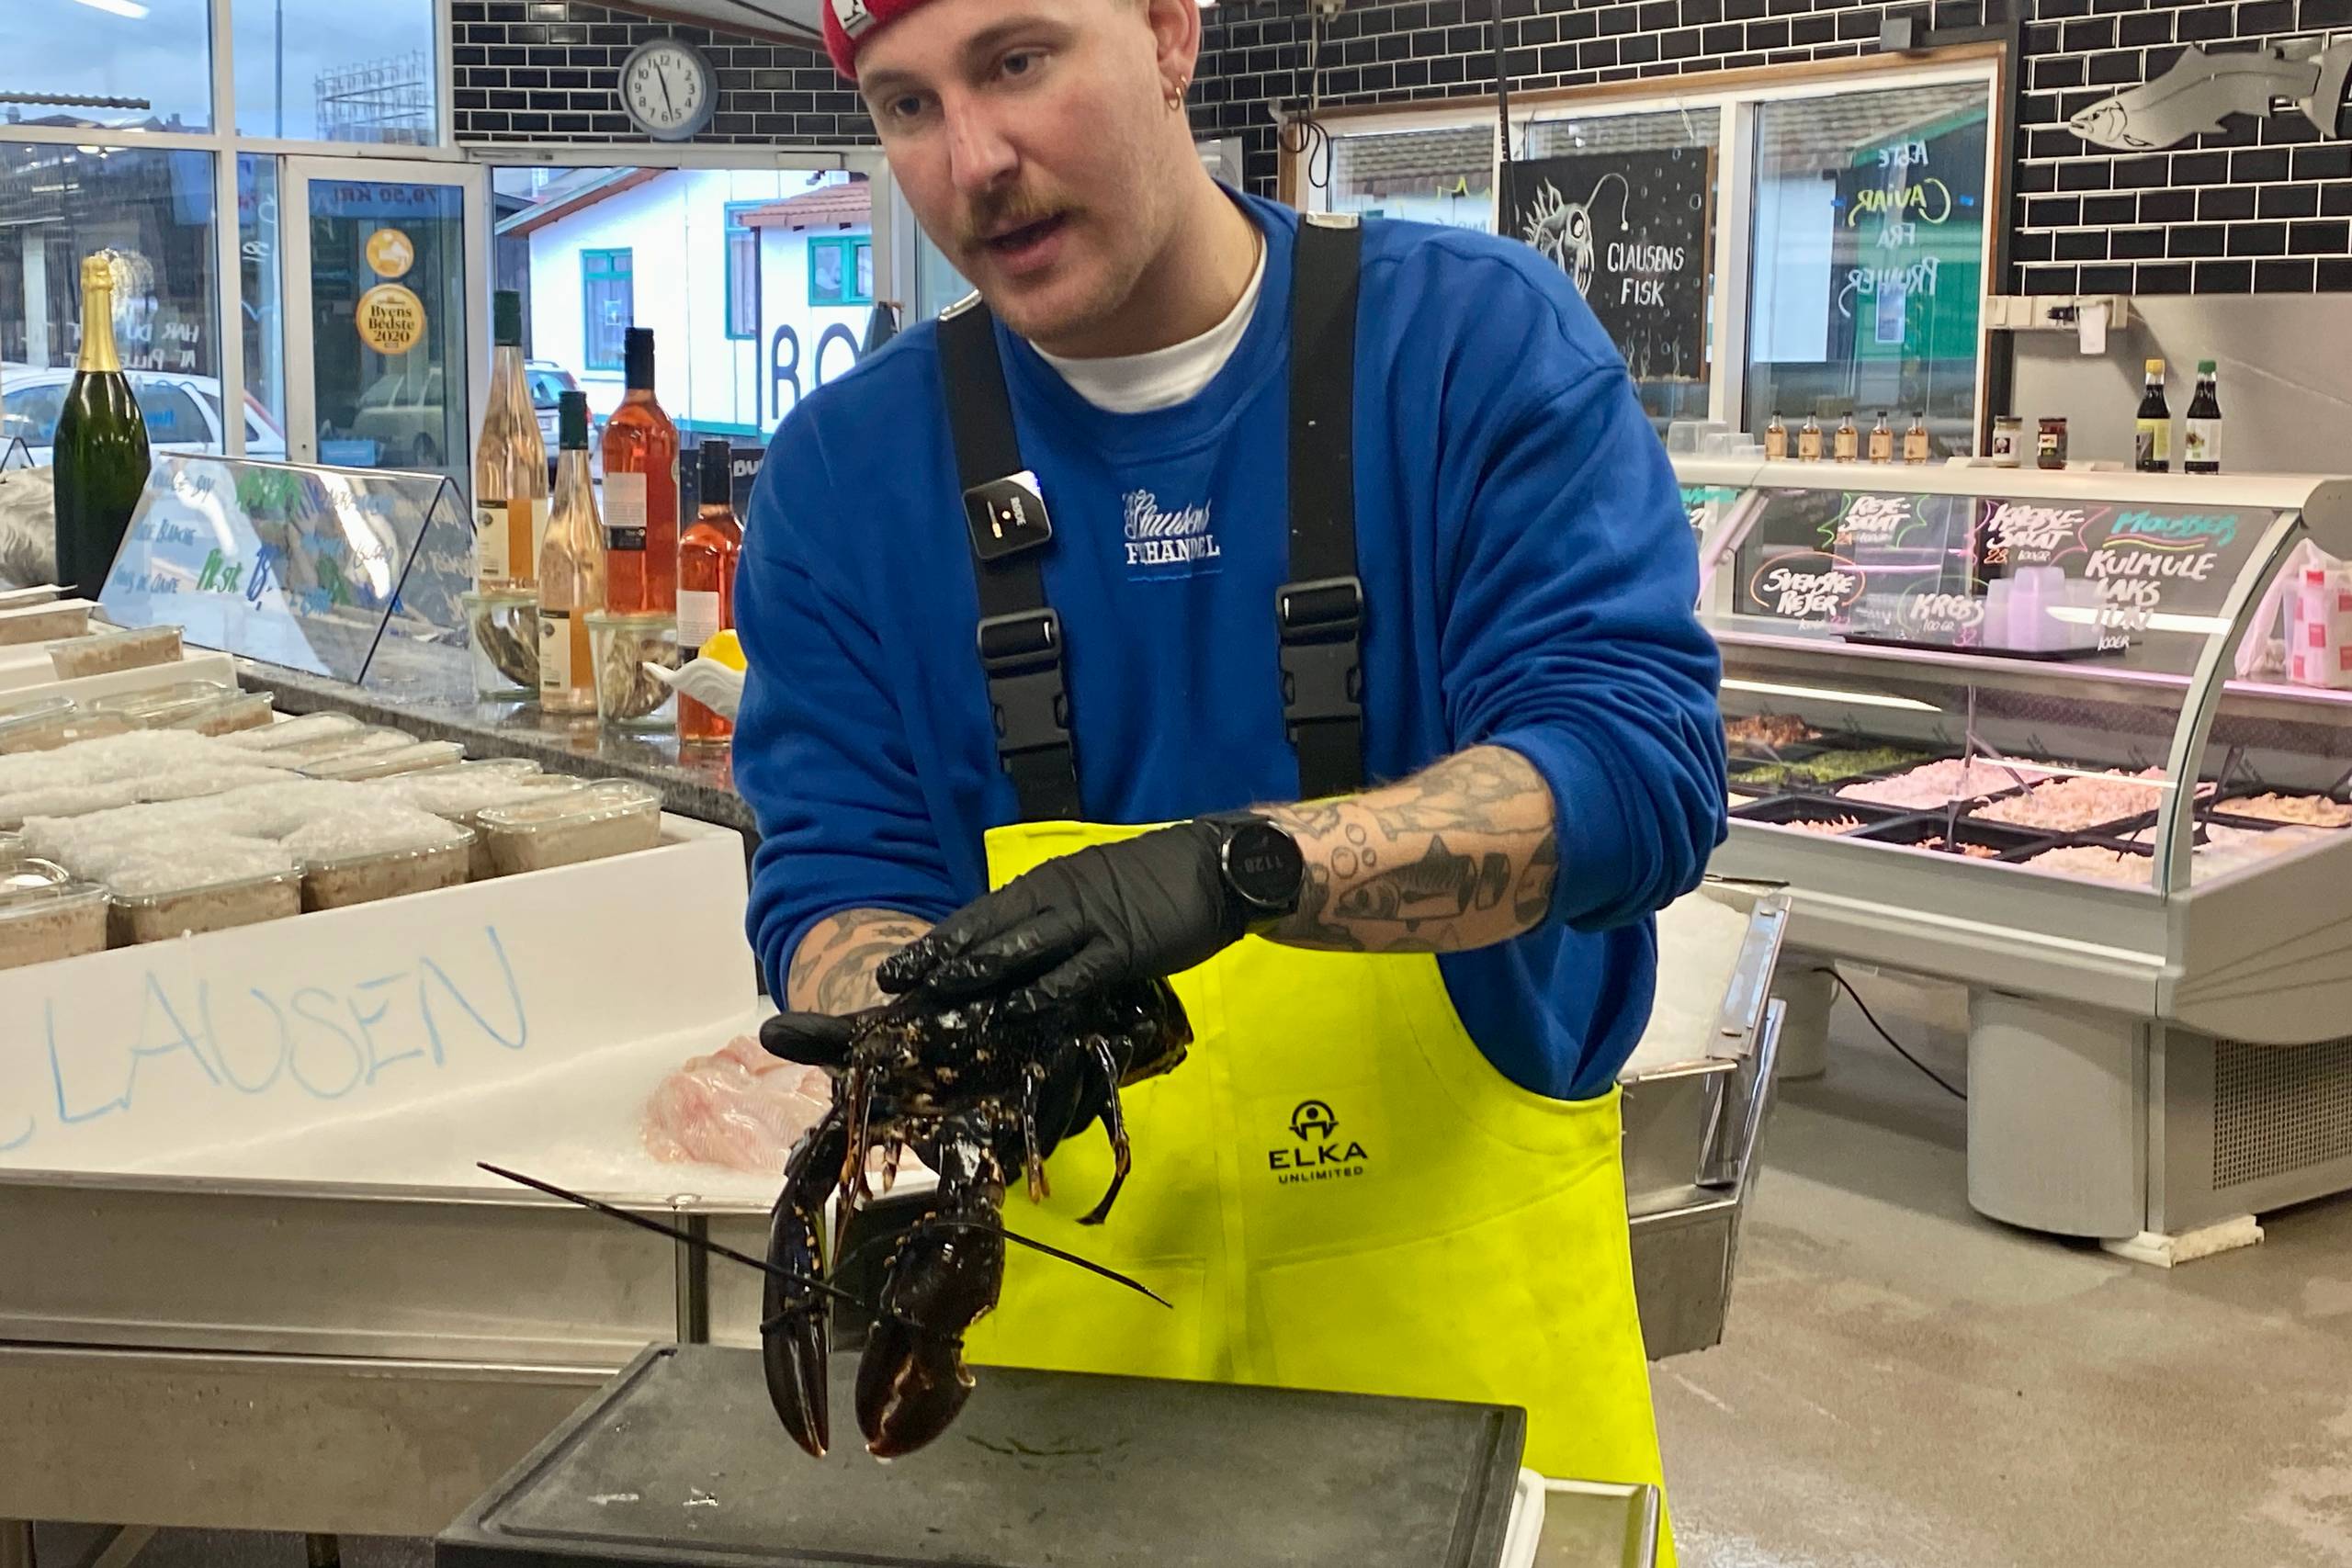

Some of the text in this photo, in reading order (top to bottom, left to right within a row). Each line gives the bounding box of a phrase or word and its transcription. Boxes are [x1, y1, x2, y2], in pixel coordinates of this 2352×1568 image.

[660, 55, 671, 66] 12
[638, 68, 649, 80] 10
[684, 70, 692, 81] 2
[634, 83, 641, 93] 9
[688, 84, 695, 95] 3
[639, 96, 647, 107] 8
[684, 97, 692, 107] 4
[650, 107, 656, 118] 7
[661, 111, 669, 122] 6
[674, 109, 682, 119] 5
[1621, 277, 1665, 308] FISK
[370, 305, 413, 318] Byens
[368, 316, 415, 331] Bedste
[373, 330, 411, 343] 2020
[2085, 549, 2217, 581] KULMULE
[2095, 577, 2161, 606] LAKS
[2092, 604, 2154, 633] TUN
[0, 924, 527, 1151] LAUSEN
[1269, 1142, 1368, 1170] ELKA
[1278, 1167, 1364, 1184] UNLIMITED
